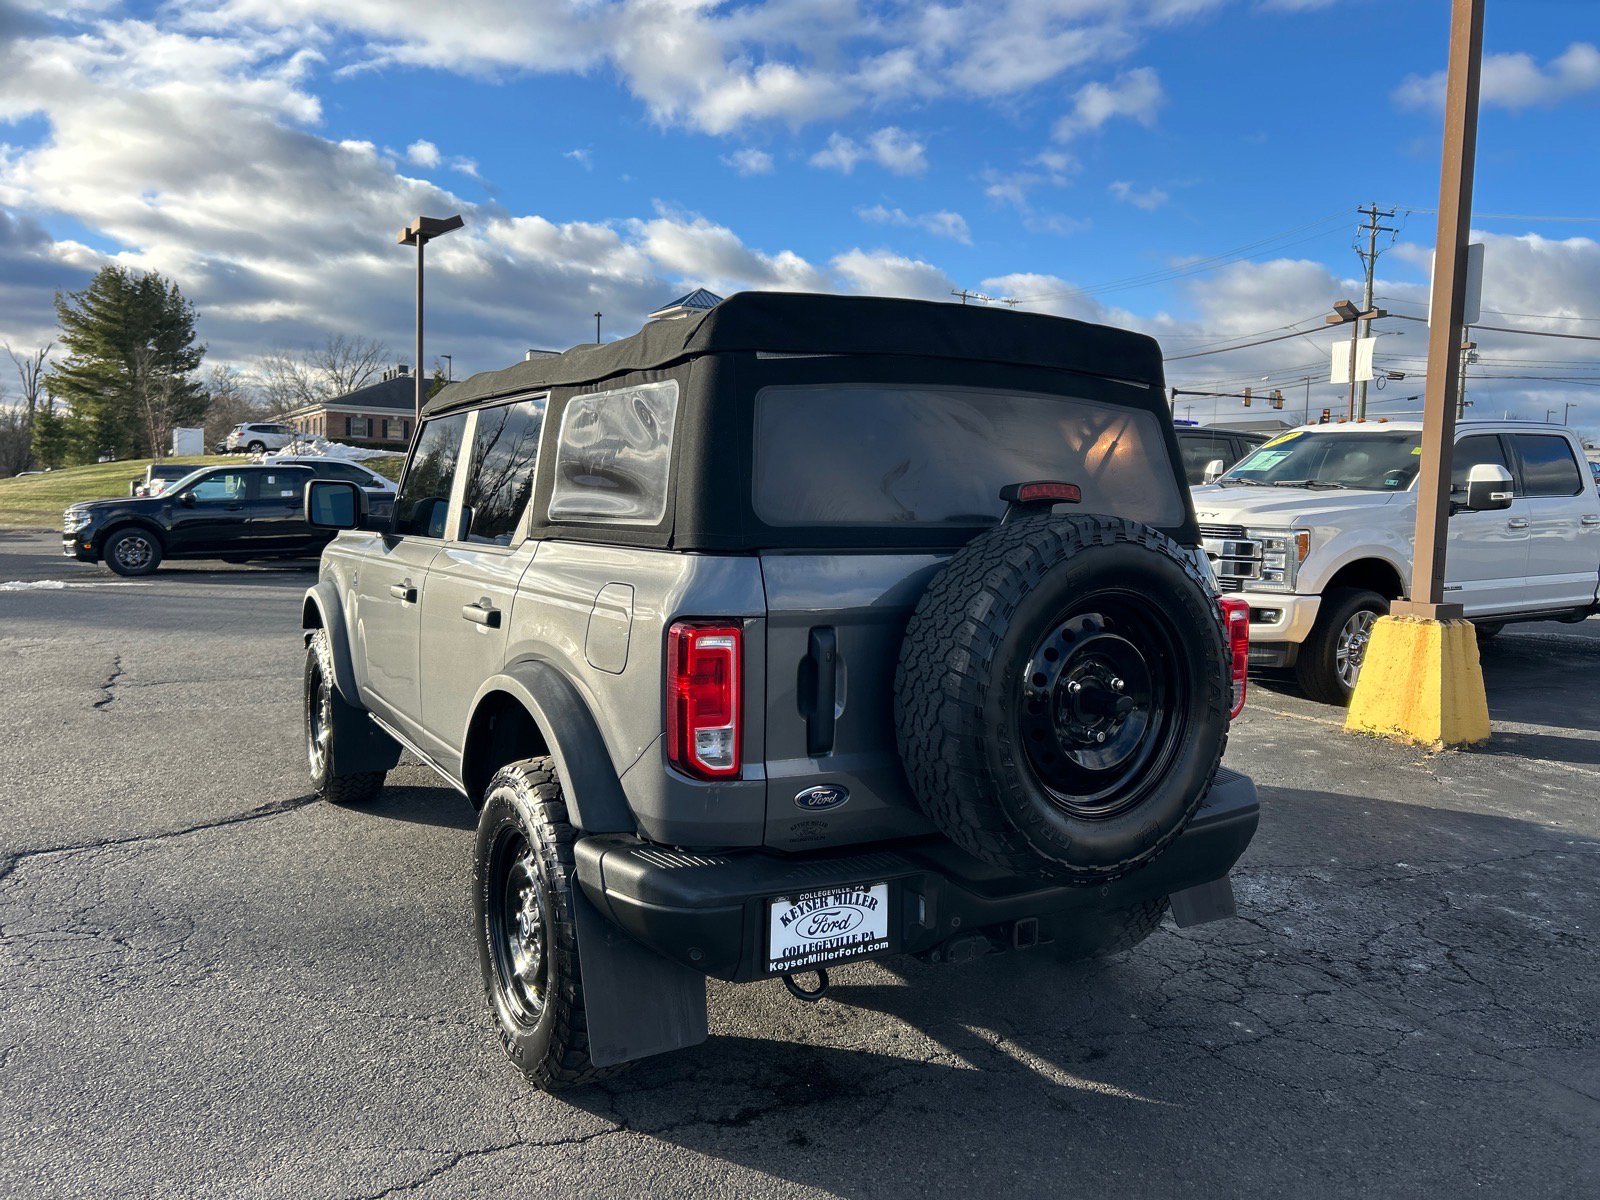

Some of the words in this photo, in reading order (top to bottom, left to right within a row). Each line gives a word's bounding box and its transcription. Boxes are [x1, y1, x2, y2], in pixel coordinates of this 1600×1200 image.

[808, 790, 838, 806] Ford
[996, 722, 1074, 850] GRABBER
[779, 896, 829, 928] KEYSER
[833, 892, 878, 912] MILLER
[808, 910, 852, 936] Ford
[861, 931, 876, 942] PA
[769, 941, 889, 972] KeyserMillerFord.com
